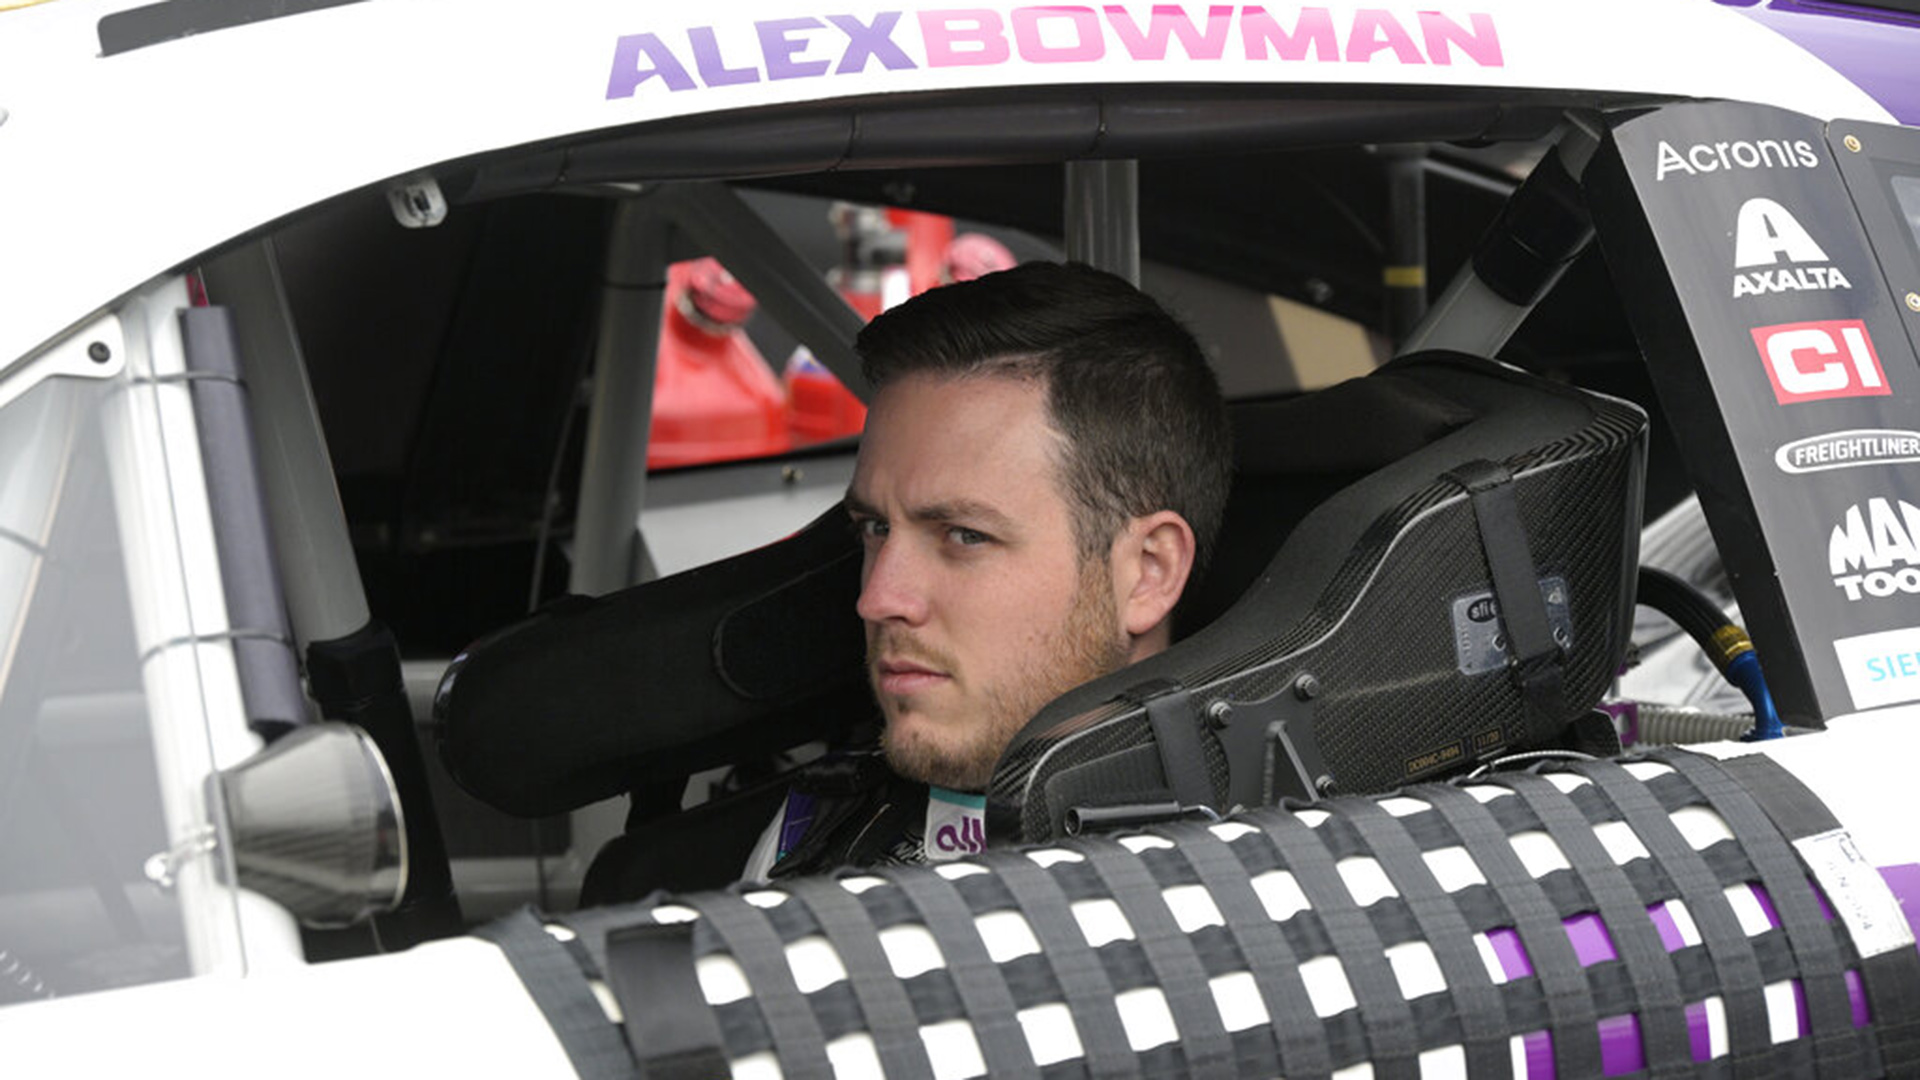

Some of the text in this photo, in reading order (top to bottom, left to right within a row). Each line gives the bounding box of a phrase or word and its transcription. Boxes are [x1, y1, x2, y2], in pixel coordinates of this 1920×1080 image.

[1656, 139, 1818, 181] Acronis
[1733, 267, 1852, 298] AXALTA
[1766, 327, 1882, 394] CI
[1794, 437, 1920, 466] FREIGHTLINER
